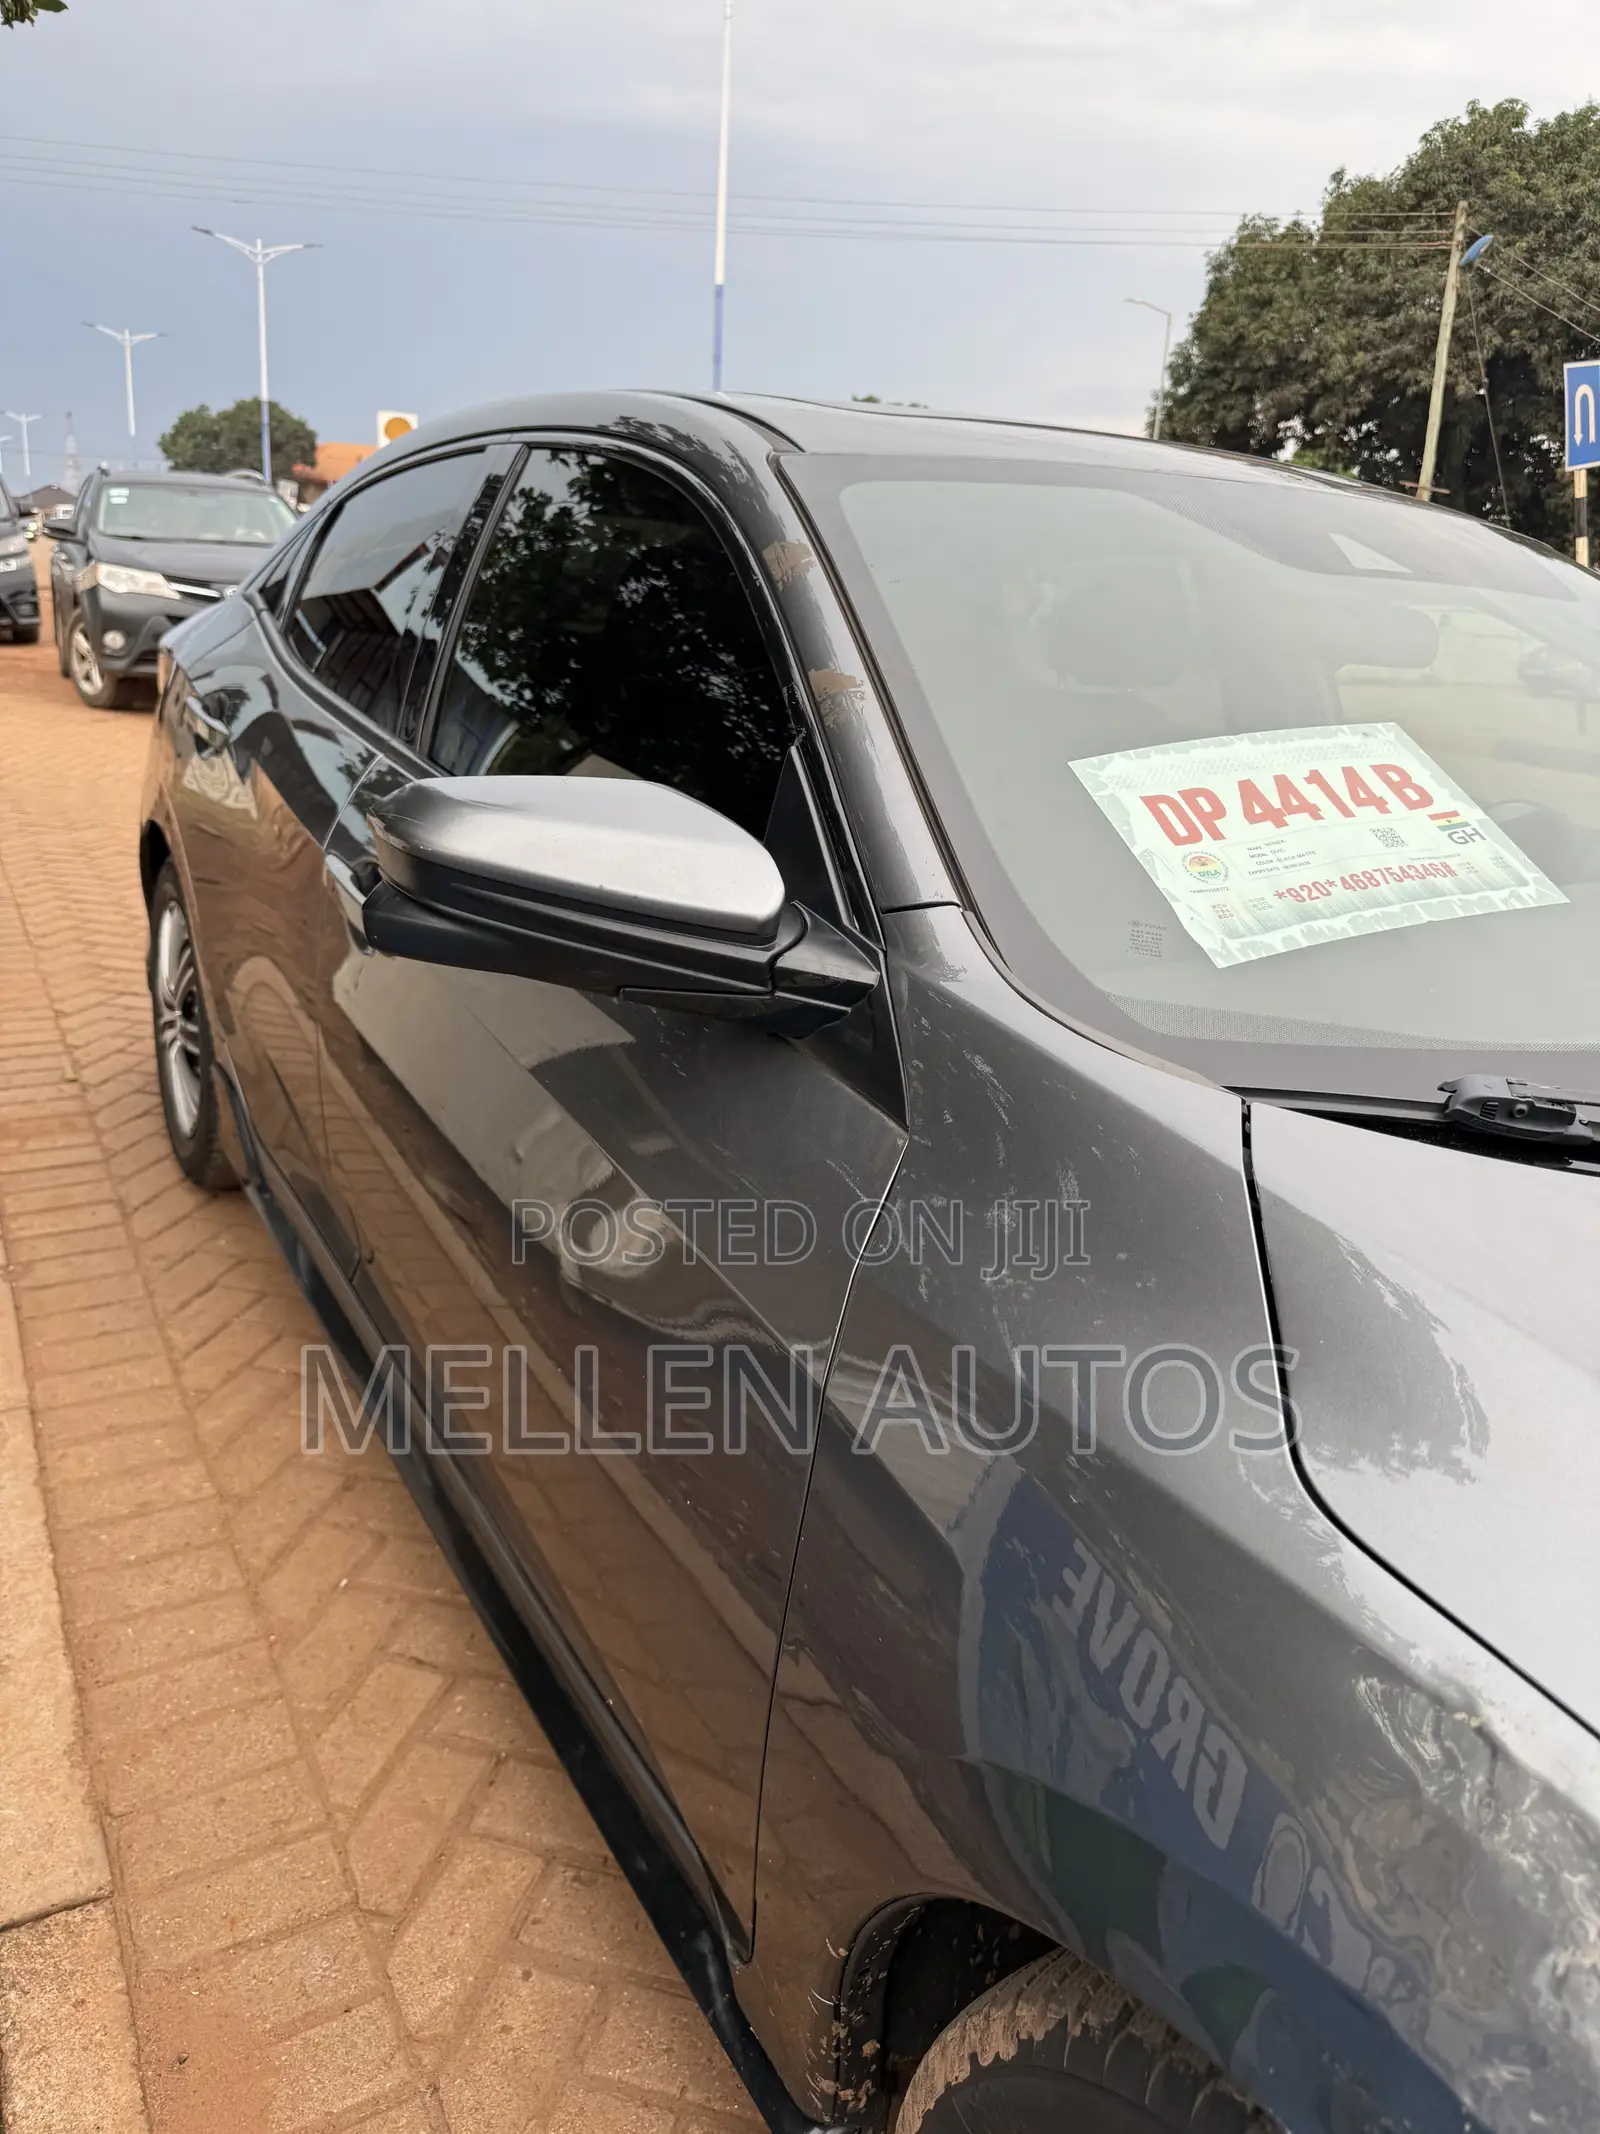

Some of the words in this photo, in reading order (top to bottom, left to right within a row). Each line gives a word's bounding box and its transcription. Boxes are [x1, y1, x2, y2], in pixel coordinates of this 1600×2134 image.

[1139, 787, 1227, 846] DP
[1237, 766, 1392, 829] 4414
[1369, 763, 1434, 811] B
[1447, 827, 1487, 845] GH
[1198, 869, 1221, 877] DVLA
